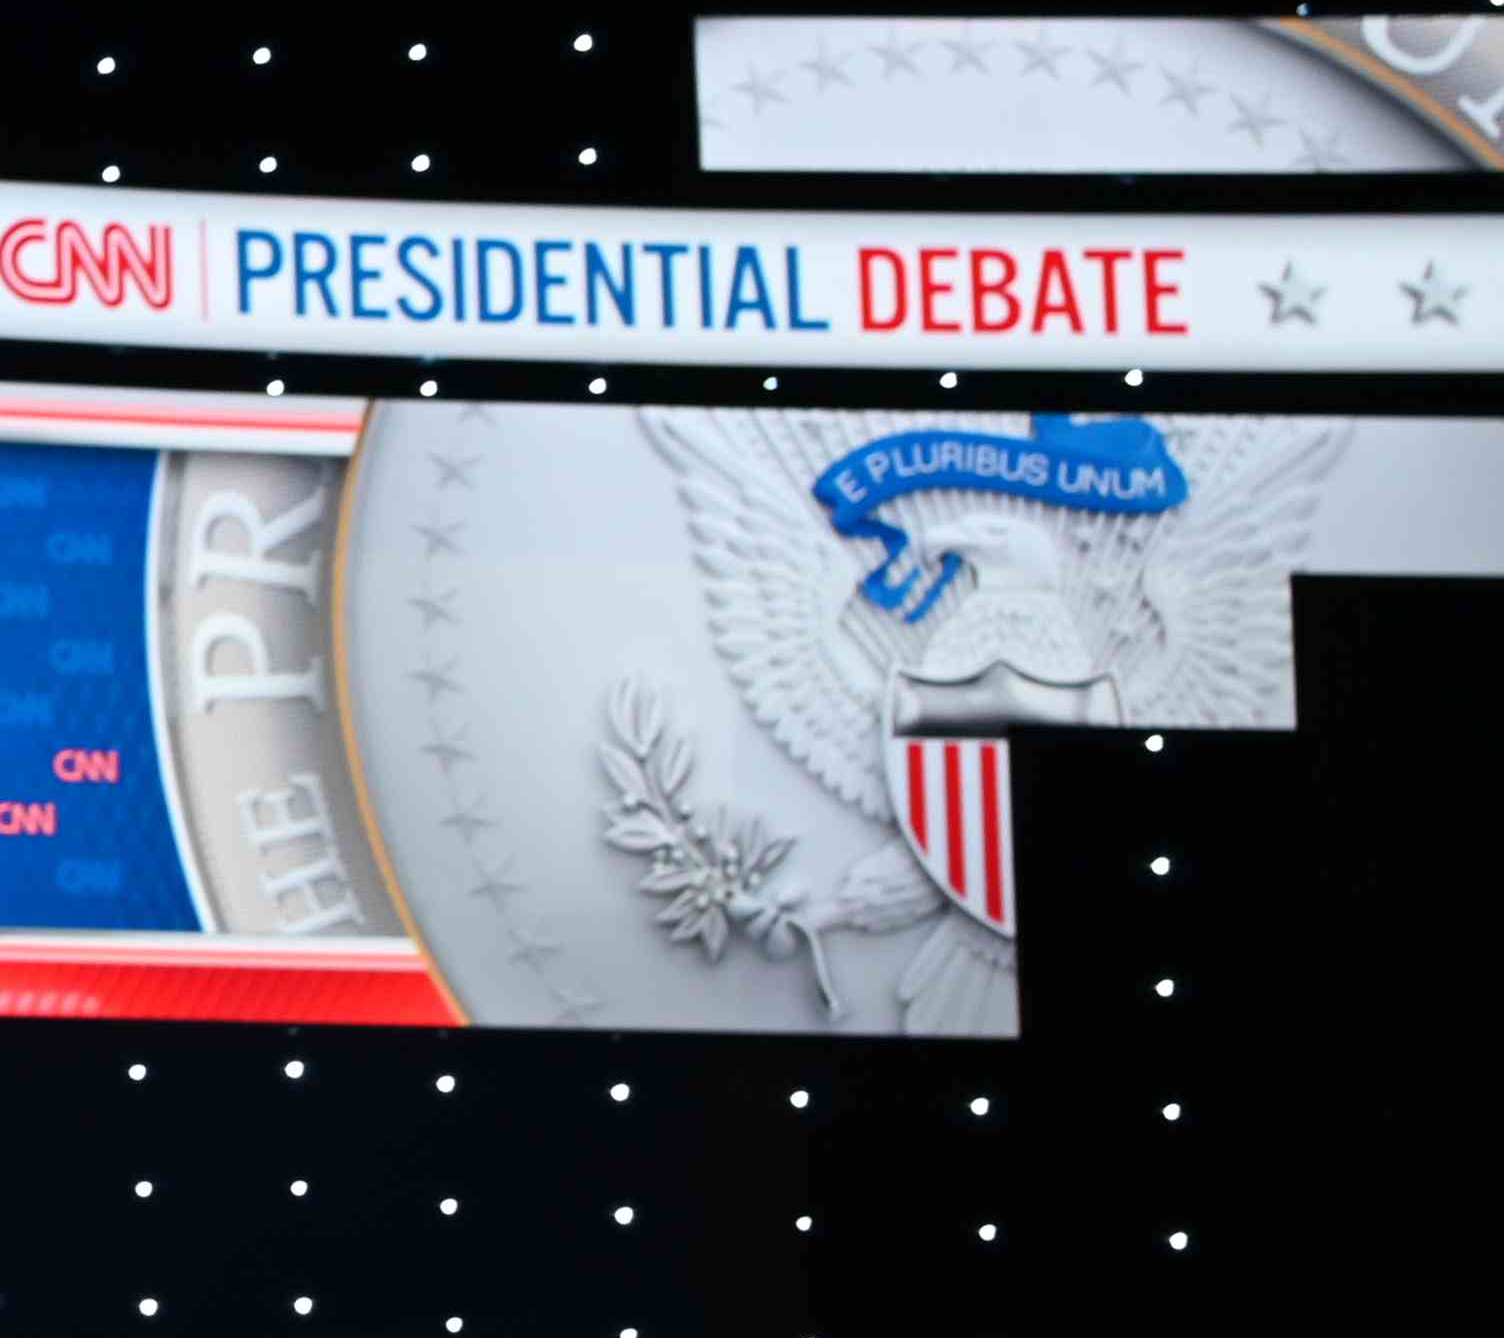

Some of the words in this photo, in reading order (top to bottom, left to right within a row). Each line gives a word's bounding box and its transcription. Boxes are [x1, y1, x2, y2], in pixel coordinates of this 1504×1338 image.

[236, 229, 829, 331] PRESIDENTIAL
[858, 246, 1188, 335] DEBATE
[834, 468, 867, 503] E
[865, 440, 1049, 487] PLURIBUS
[1057, 461, 1166, 499] UNUM
[54, 749, 120, 783] CNN
